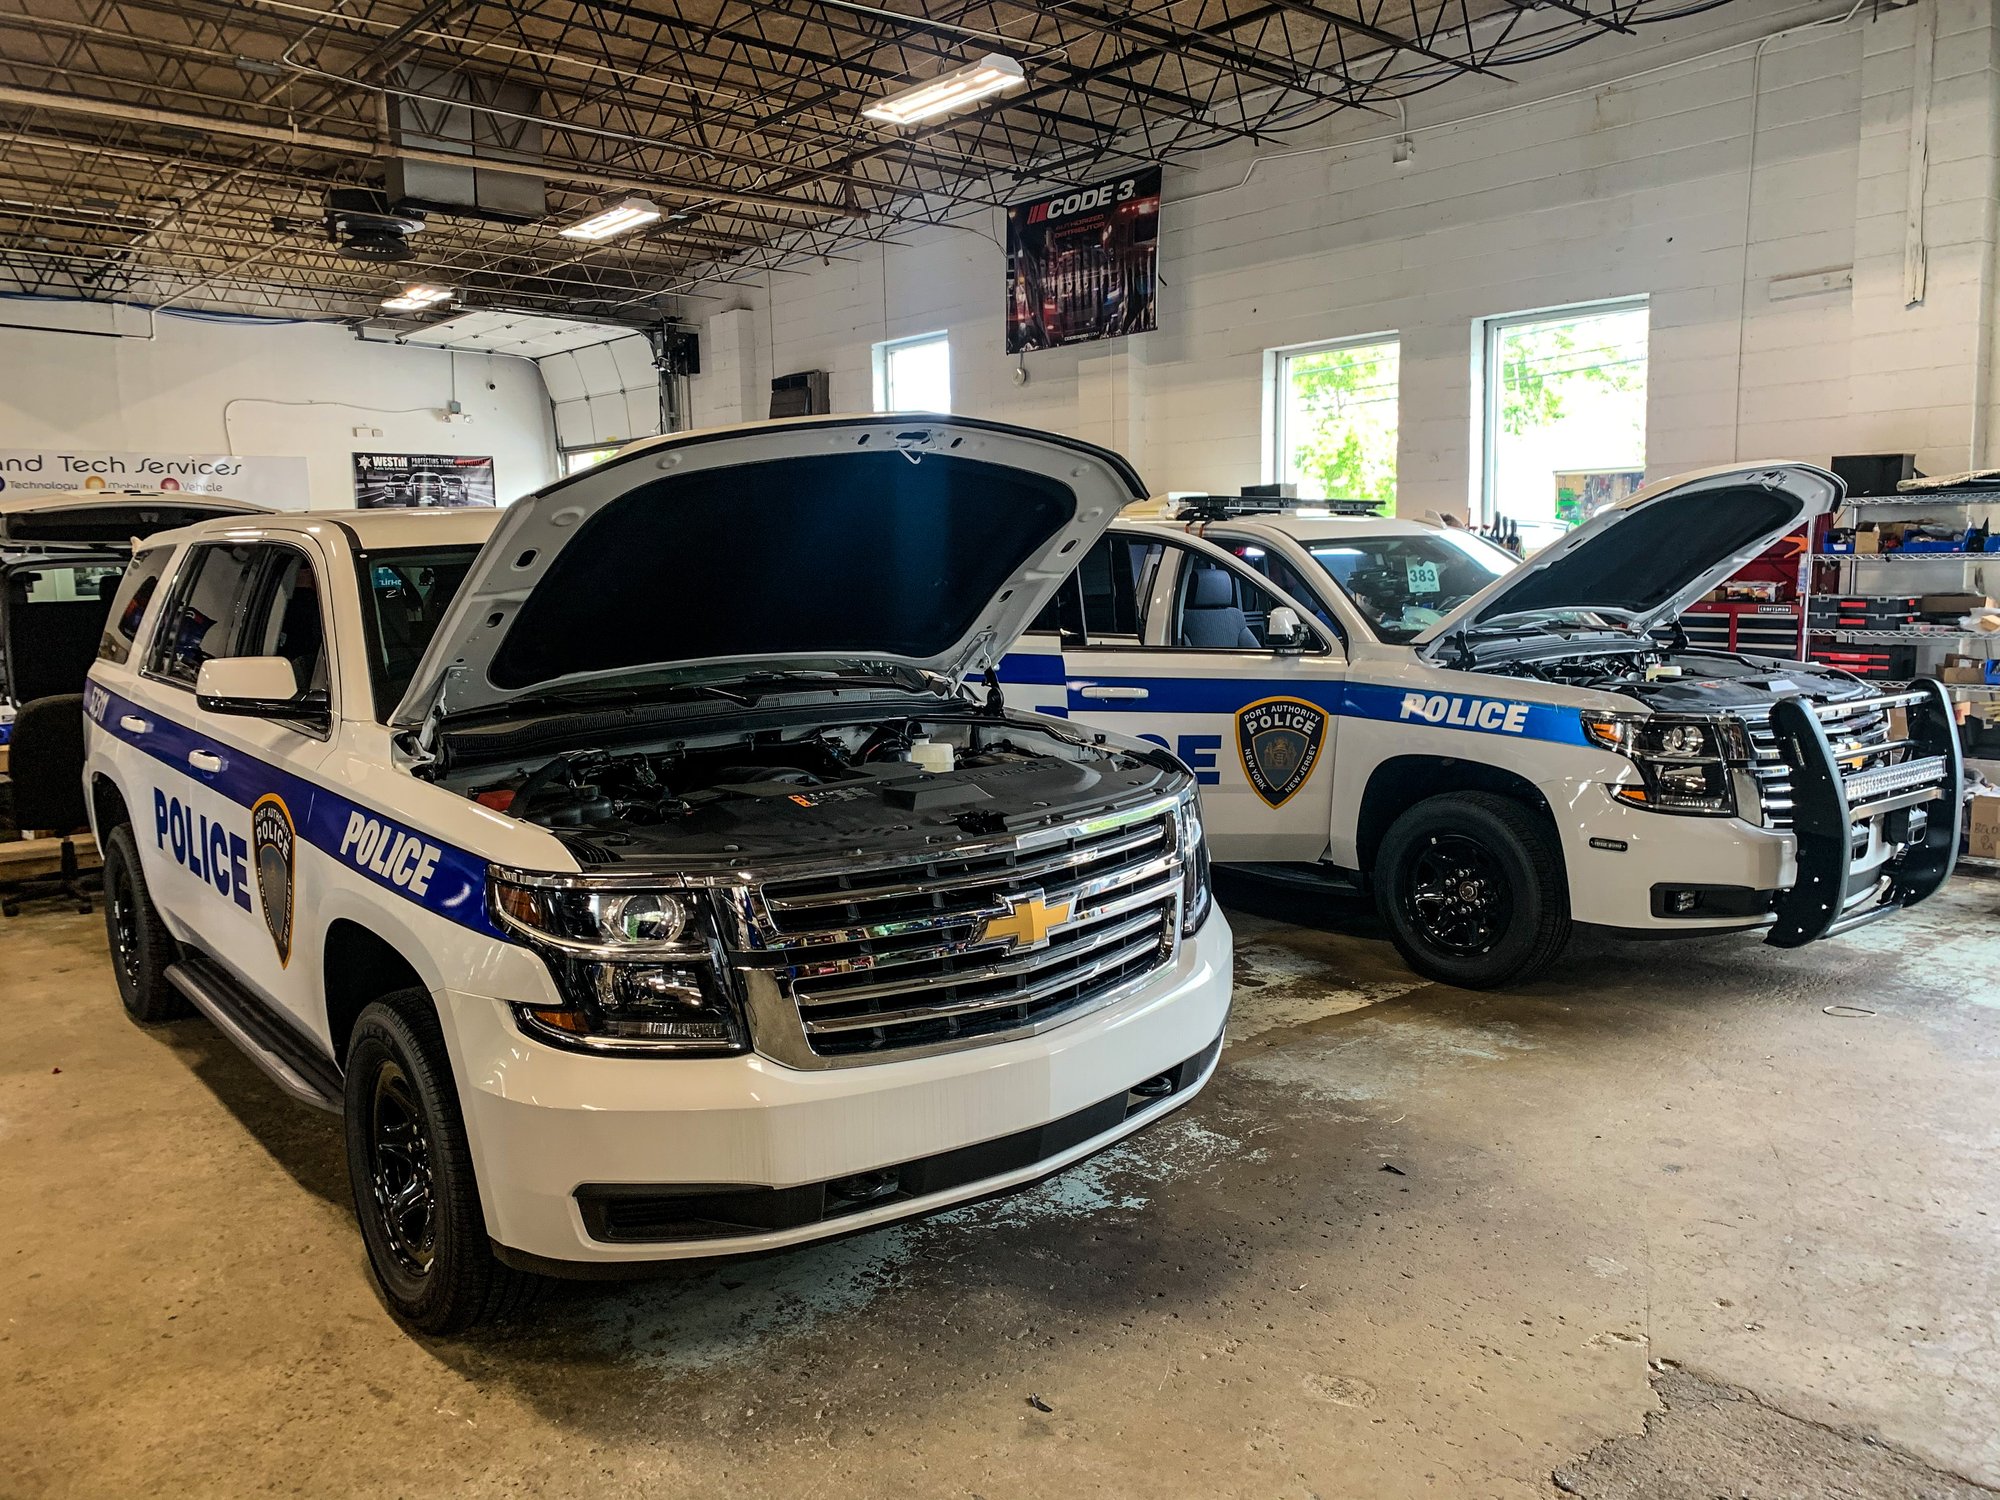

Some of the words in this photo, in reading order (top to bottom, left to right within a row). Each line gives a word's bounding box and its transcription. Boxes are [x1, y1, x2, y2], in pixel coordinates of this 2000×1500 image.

[1047, 184, 1114, 219] CODE
[1117, 180, 1135, 200] 3
[0, 455, 42, 472] nd
[57, 455, 125, 473] Tech
[135, 458, 242, 475] Services
[9, 481, 79, 491] Technology
[181, 482, 223, 492] Vehicle
[1409, 569, 1436, 583] 383
[1244, 707, 1267, 722] PORT
[1271, 705, 1321, 723] AUTHORITY
[1246, 713, 1316, 735] POLICE
[1400, 692, 1530, 733] POLICE
[1244, 748, 1256, 768] NEW
[1251, 768, 1267, 790] YORK
[1284, 775, 1301, 793] NEW
[1300, 744, 1317, 776] JERSEY
[255, 807, 267, 826] PORT
[267, 808, 292, 843] AUTHORITY
[256, 820, 290, 861] POLICE
[153, 786, 253, 914] POLICE
[340, 810, 442, 897] POLICE
